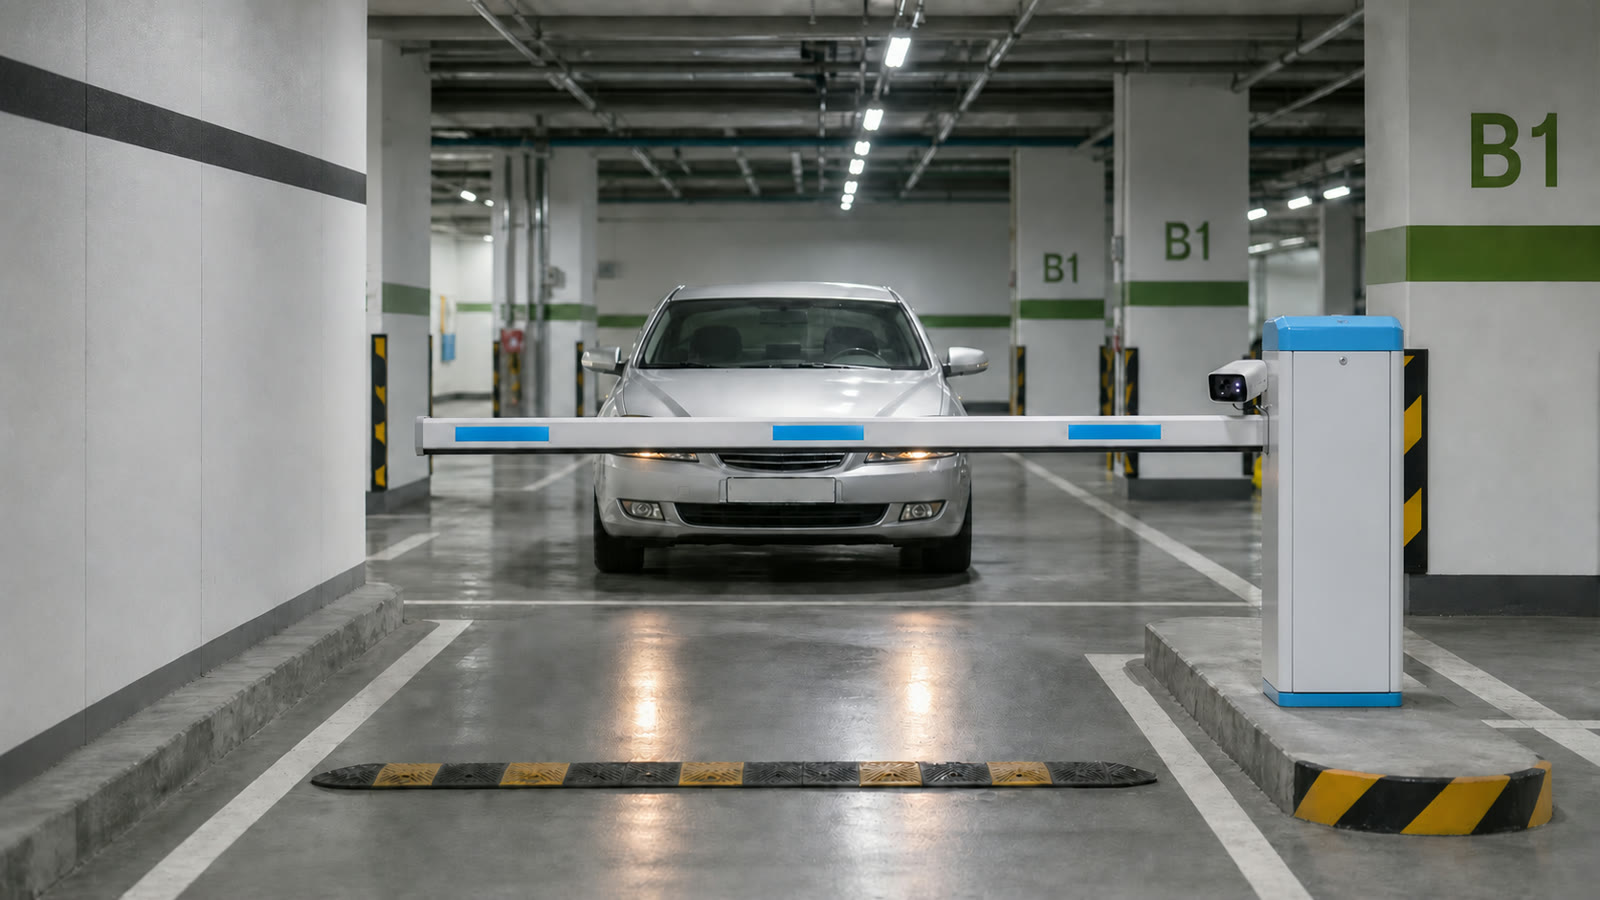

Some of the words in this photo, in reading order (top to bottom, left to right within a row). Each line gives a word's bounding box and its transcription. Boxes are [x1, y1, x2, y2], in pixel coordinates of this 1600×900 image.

[1471, 112, 1558, 188] B1
[1165, 221, 1209, 261] B1
[1043, 253, 1078, 283] B1
